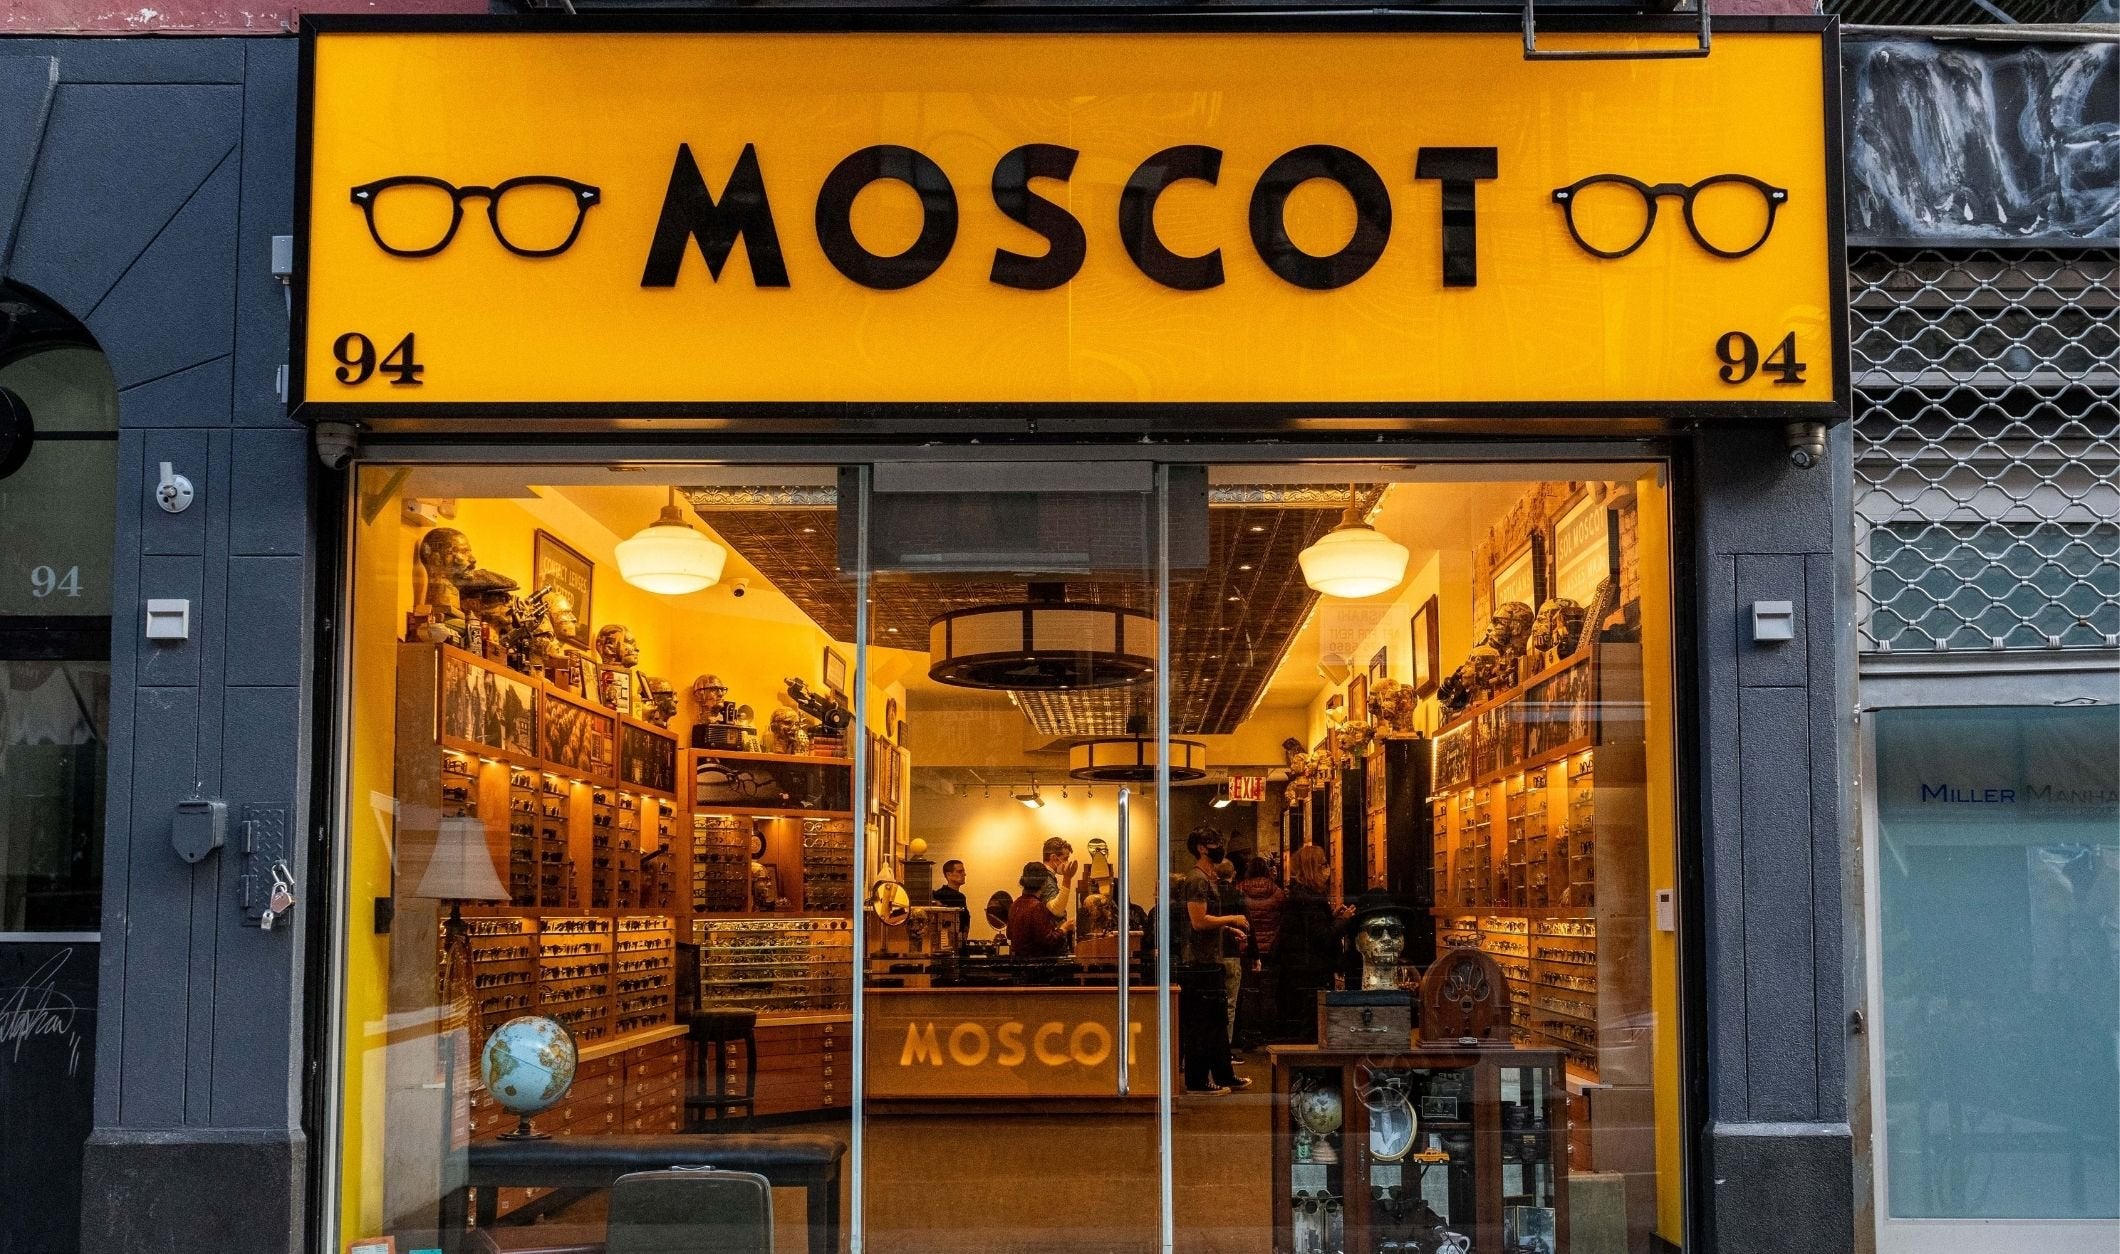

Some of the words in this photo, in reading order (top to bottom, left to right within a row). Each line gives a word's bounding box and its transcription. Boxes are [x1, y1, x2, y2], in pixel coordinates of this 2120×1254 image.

[640, 142, 1499, 291] MOSCOT
[333, 332, 424, 386] 94
[1715, 331, 1807, 385] 94
[1573, 505, 1605, 548] MOSCOT
[31, 565, 84, 598] 94
[1233, 776, 1263, 800] EXIT
[1921, 783, 2016, 803] MILLER
[900, 1021, 1142, 1066] MOSCOT
